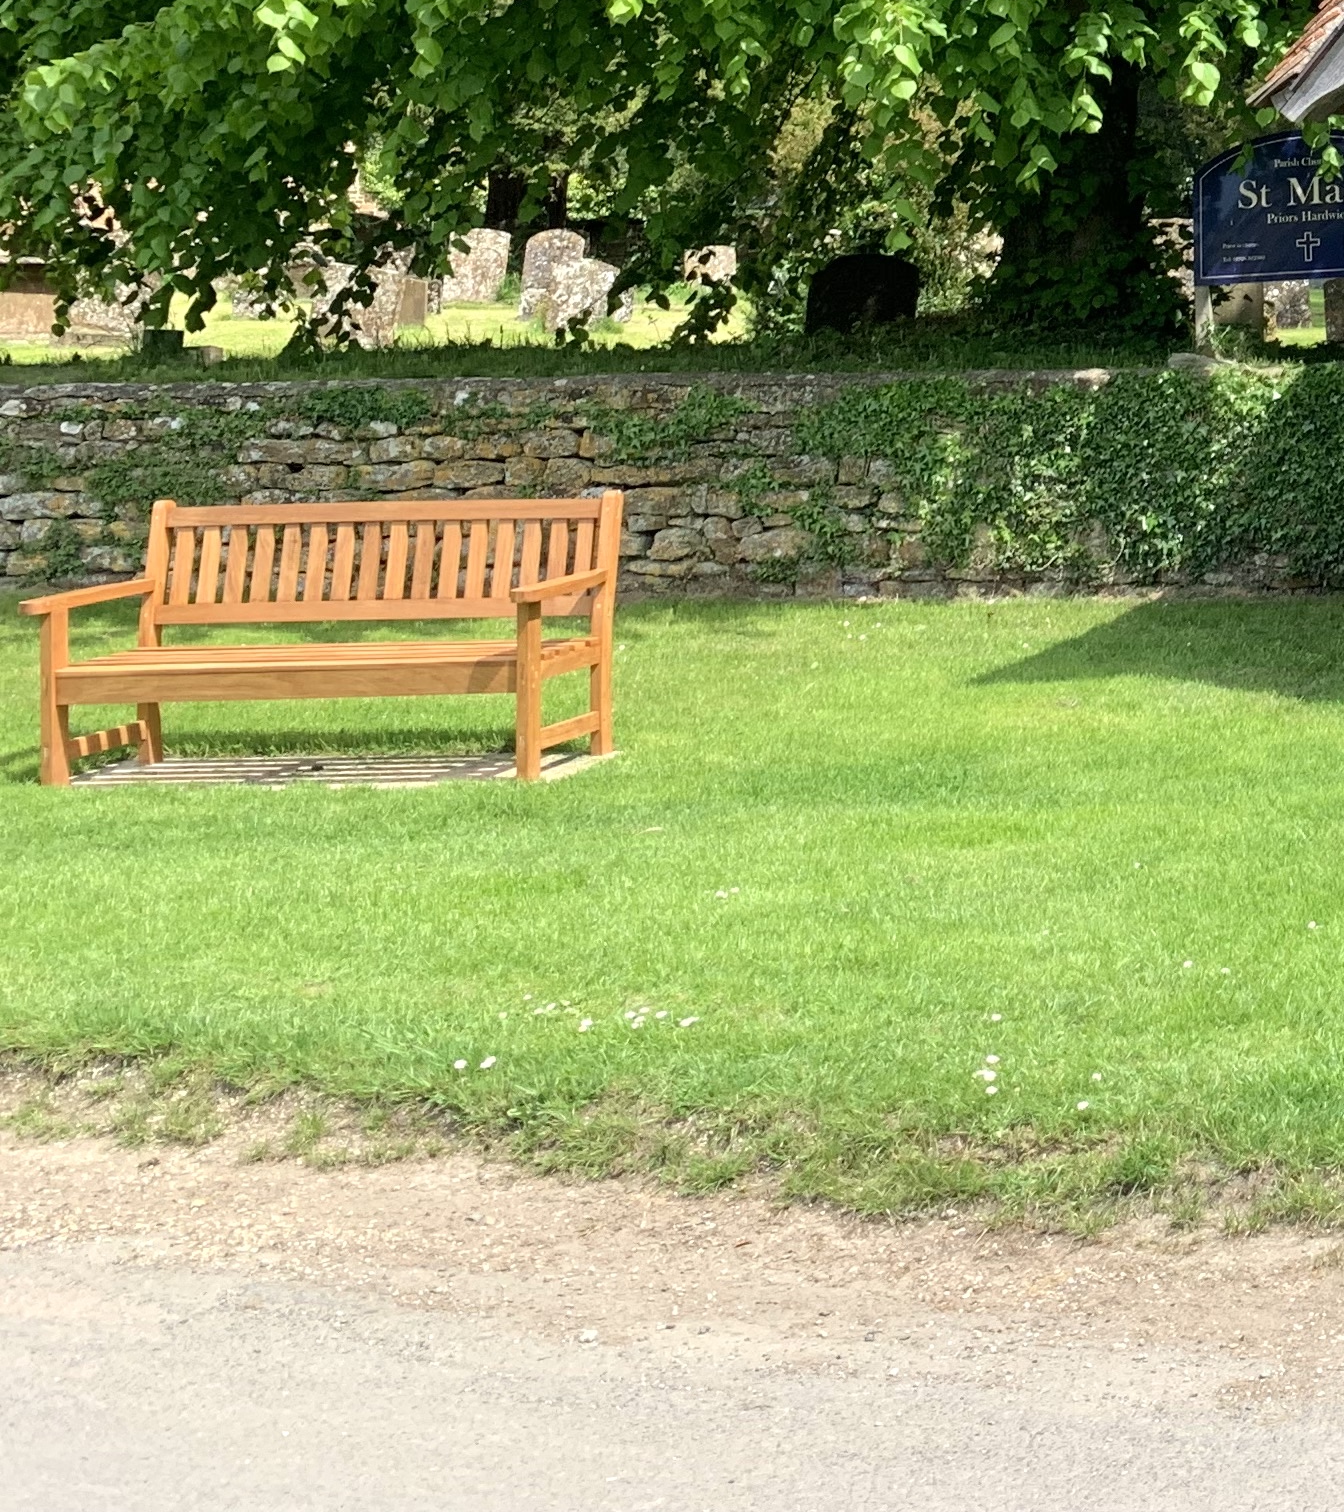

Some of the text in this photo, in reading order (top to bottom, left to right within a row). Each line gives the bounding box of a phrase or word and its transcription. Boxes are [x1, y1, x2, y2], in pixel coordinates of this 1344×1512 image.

[1274, 157, 1300, 168] Parish
[1238, 179, 1273, 209] St
[1267, 212, 1299, 225] Priors
